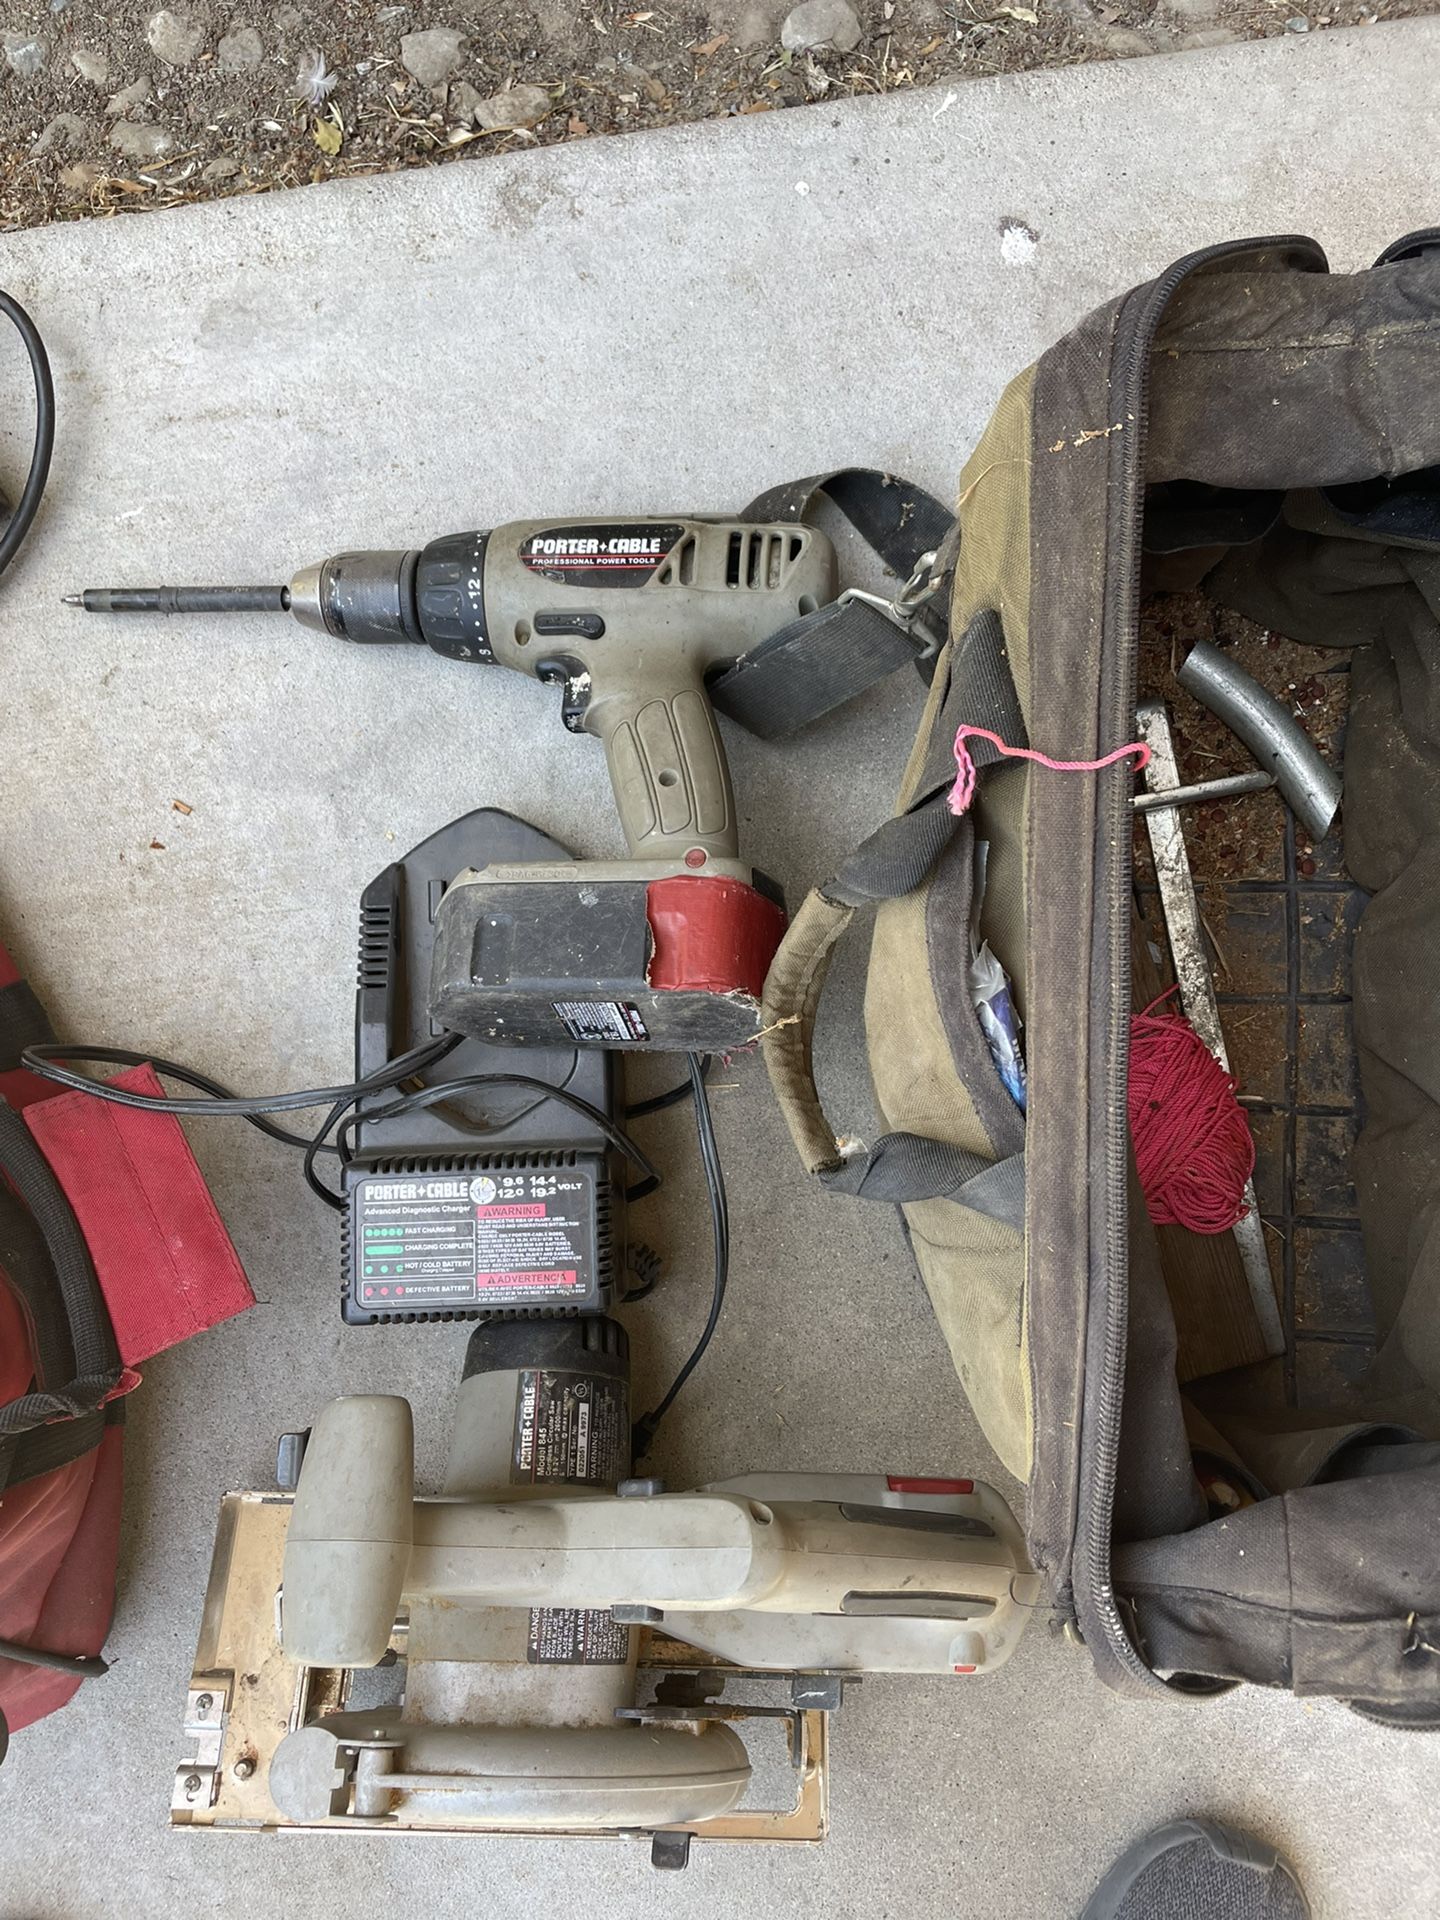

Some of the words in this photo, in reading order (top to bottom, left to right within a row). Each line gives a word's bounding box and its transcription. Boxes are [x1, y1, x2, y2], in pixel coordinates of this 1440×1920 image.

[468, 578, 481, 600] 12
[502, 1176, 524, 1187] 9.6
[530, 1176, 556, 1186] 14.4
[498, 1188, 524, 1198] 12.0
[530, 1187, 556, 1198] 19.2
[364, 1207, 401, 1216] Advanced
[402, 1206, 440, 1216] Diagnostic
[442, 1205, 471, 1214] Charger
[492, 1206, 540, 1216] WARNING
[497, 1273, 566, 1284] ADVERTENCIA
[538, 1428, 547, 1445] 845
[530, 1608, 540, 1639] DANGE
[577, 1609, 586, 1641] WARNI
[586, 1650, 591, 1659] TO
